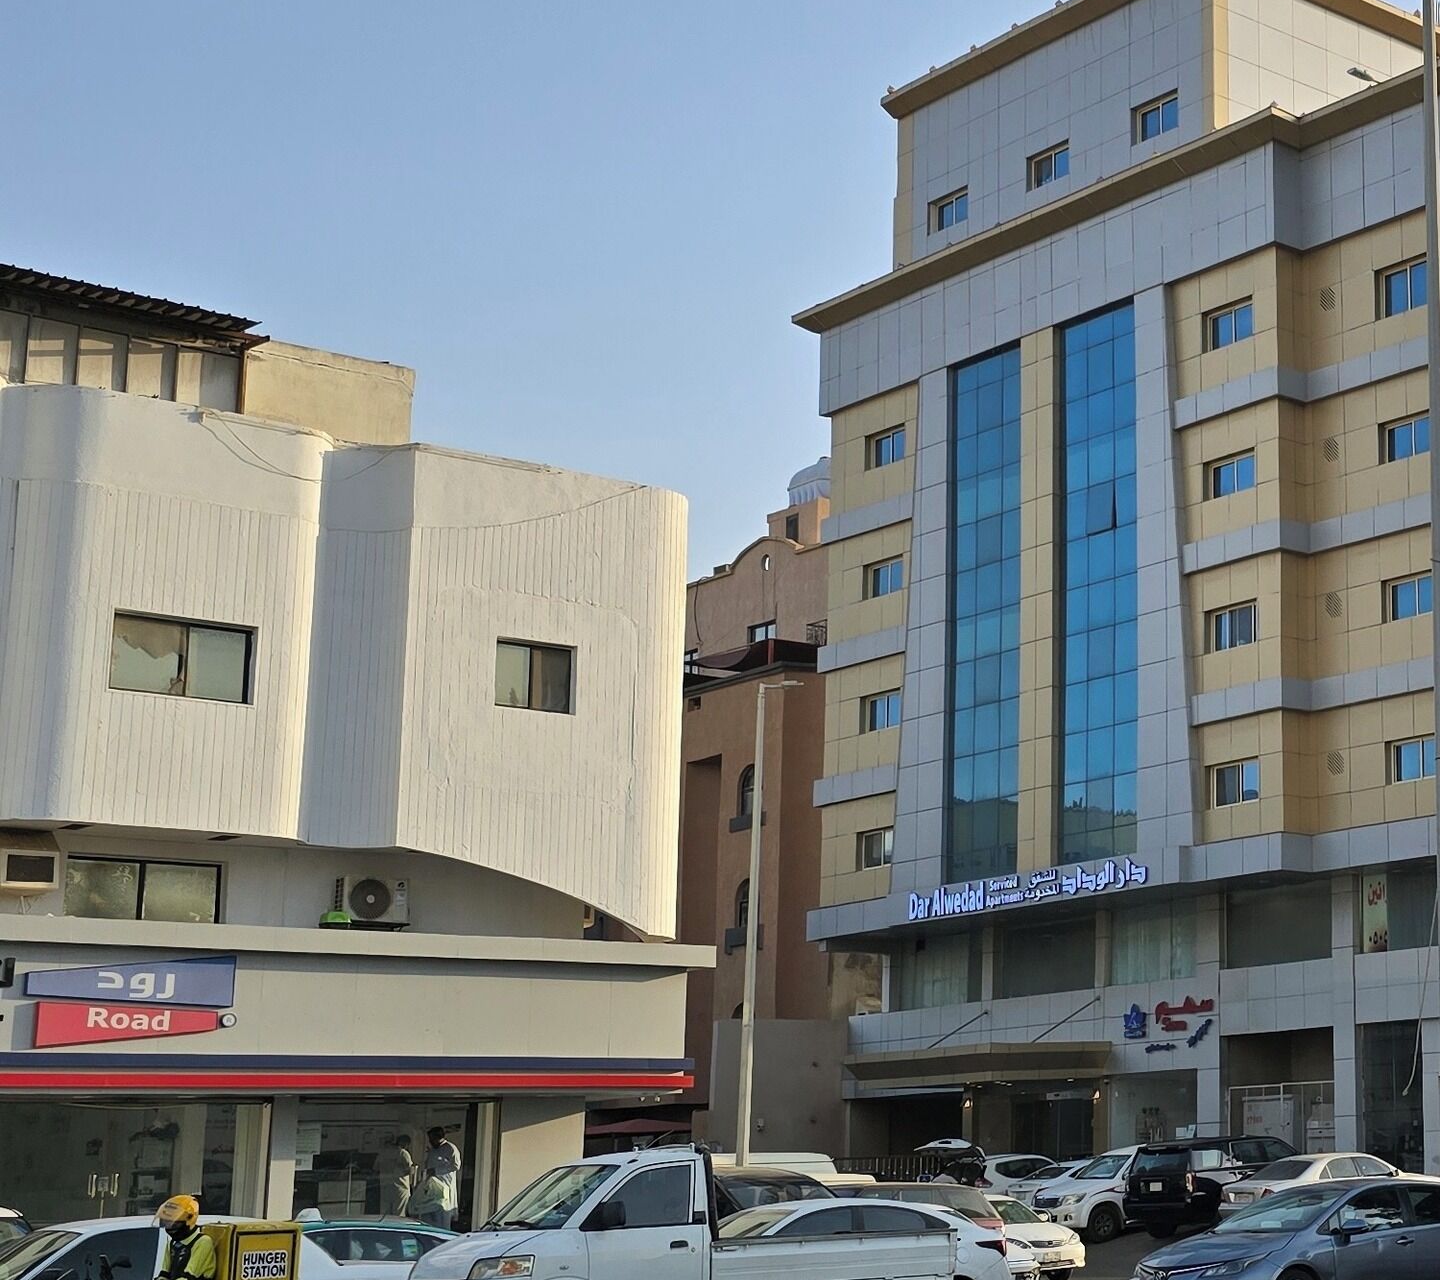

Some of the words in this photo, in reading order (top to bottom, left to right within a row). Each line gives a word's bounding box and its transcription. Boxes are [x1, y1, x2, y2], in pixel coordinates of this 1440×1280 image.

[989, 875, 1018, 892] Serviced
[1062, 860, 1115, 895] الوداد
[1115, 857, 1146, 888] دار
[908, 892, 930, 920] Dar
[932, 881, 984, 917] Alwedad
[986, 891, 1024, 909] Apartments
[97, 970, 176, 999] رود
[86, 1007, 171, 1031] Road
[243, 1252, 287, 1266] HUNGER
[242, 1264, 286, 1279] STATION
